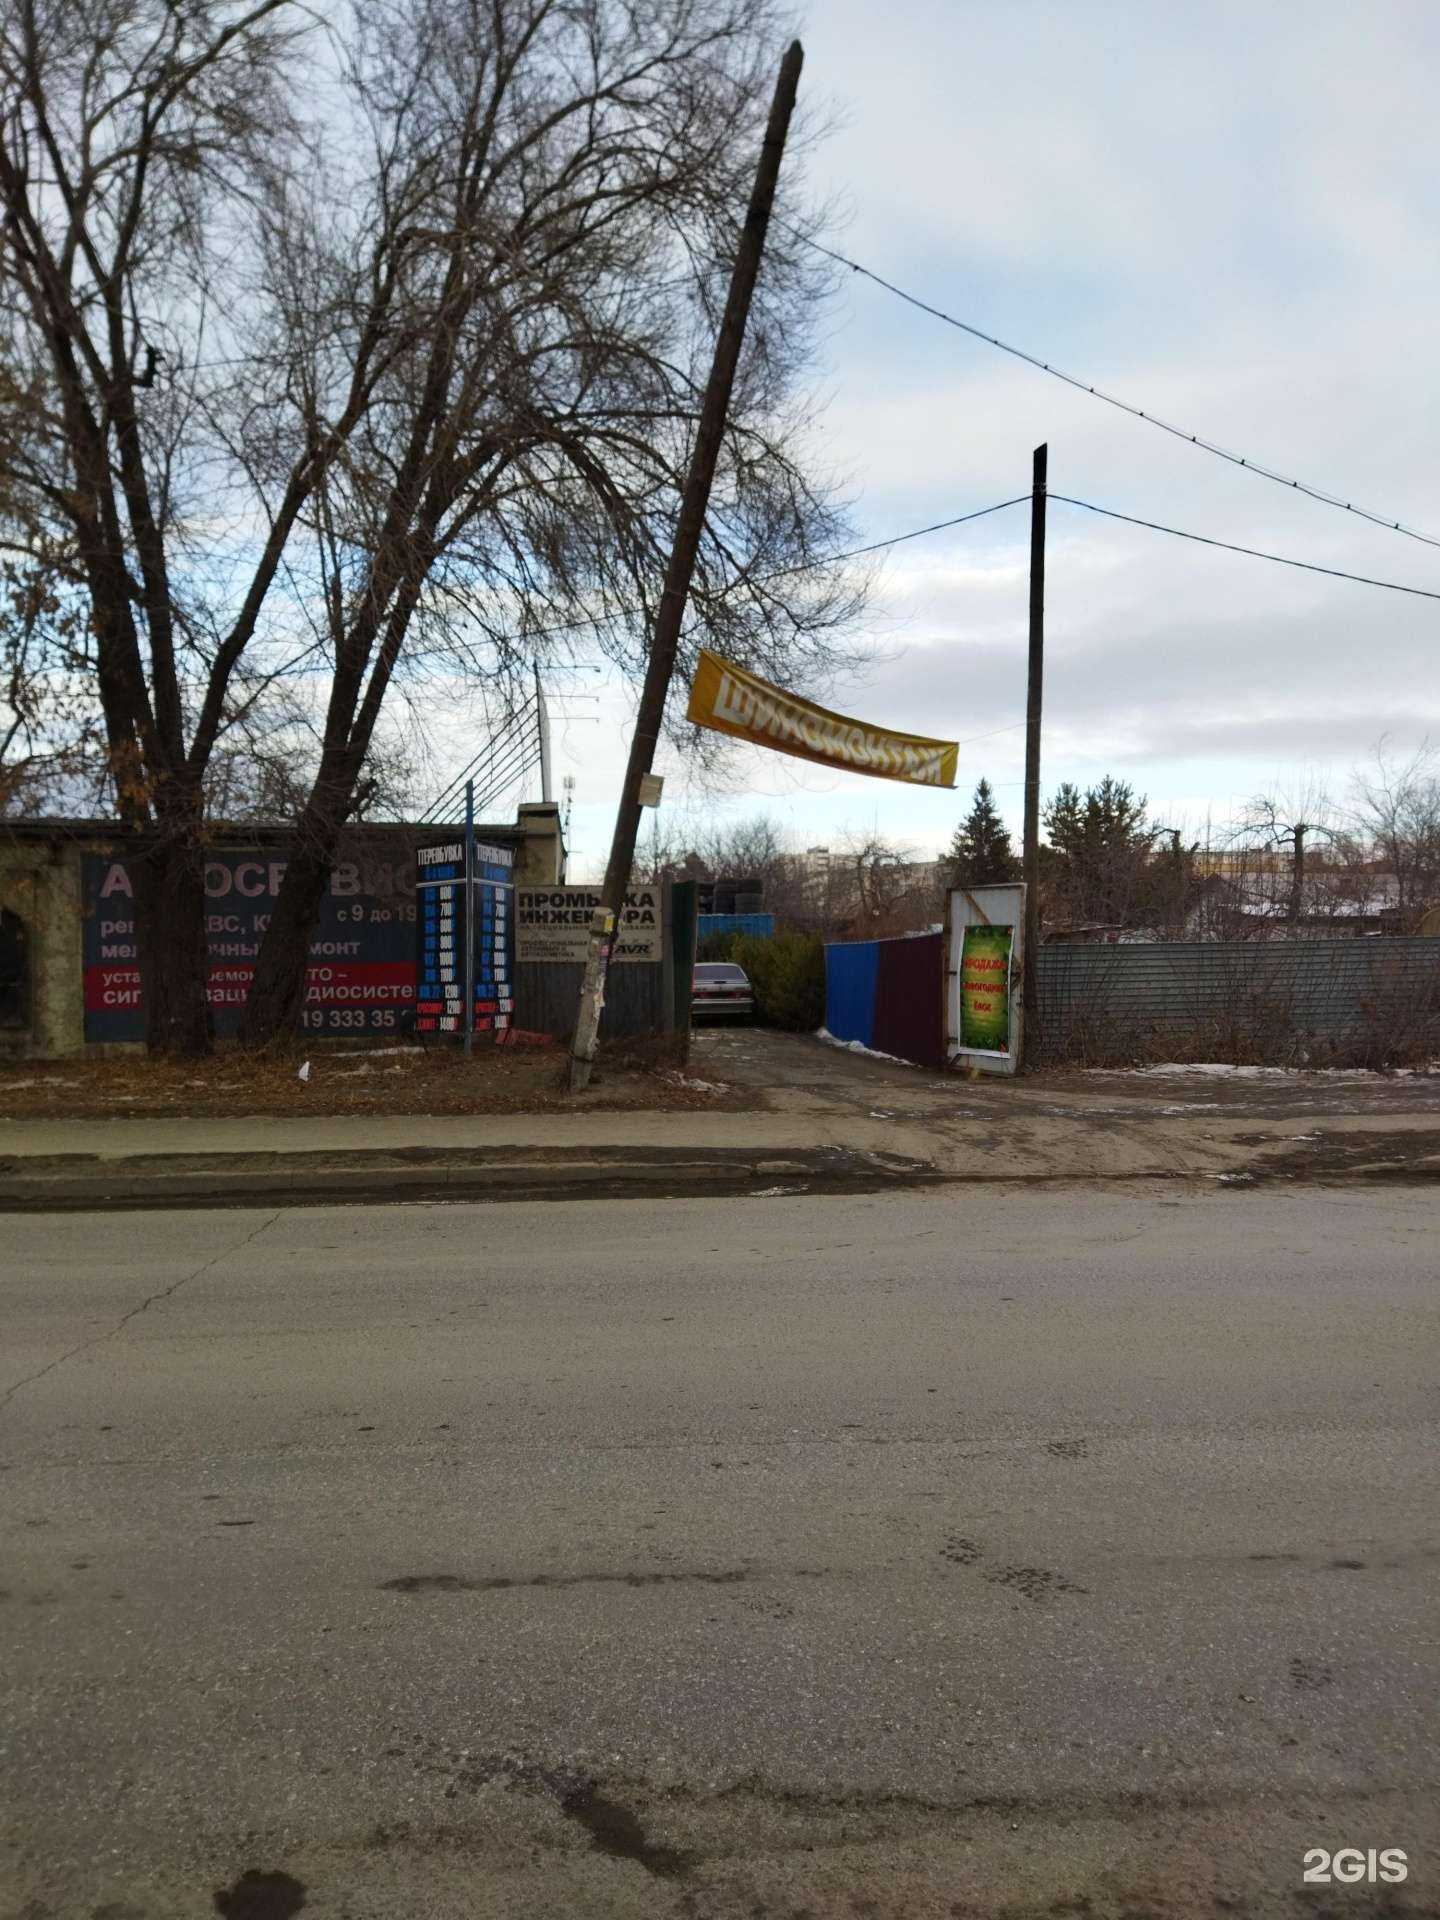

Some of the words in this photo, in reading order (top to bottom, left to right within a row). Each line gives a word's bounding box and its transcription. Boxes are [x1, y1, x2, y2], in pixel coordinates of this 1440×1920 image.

[518, 891, 656, 909] ПРОМЫКА
[329, 1010, 366, 1028] 333
[370, 1010, 395, 1028] 35
